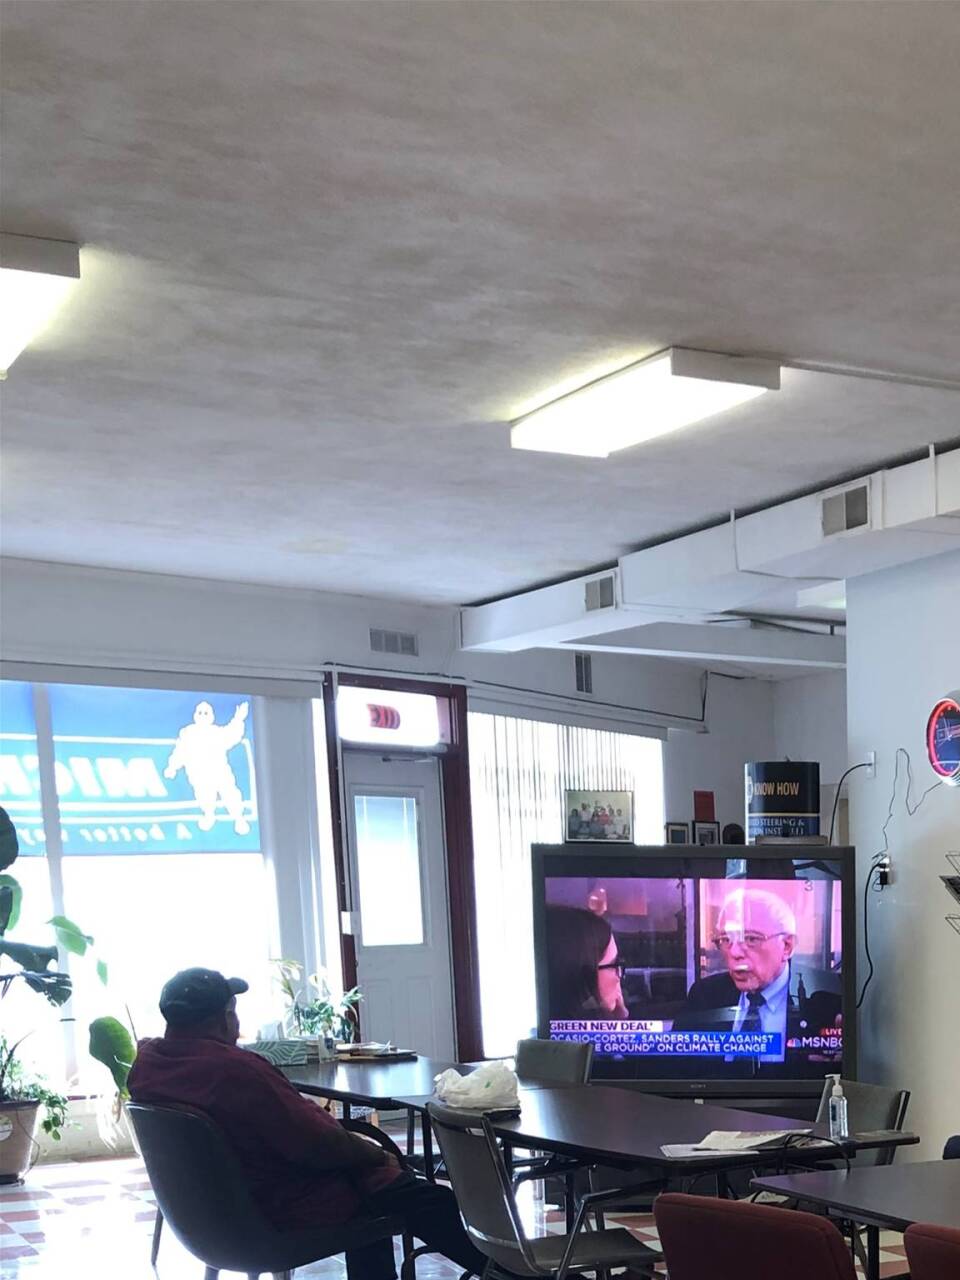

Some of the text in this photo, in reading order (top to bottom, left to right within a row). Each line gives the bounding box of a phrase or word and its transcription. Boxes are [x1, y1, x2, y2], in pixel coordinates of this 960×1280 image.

[777, 782, 800, 796] HOW
[591, 1022, 617, 1031] NEW
[642, 1034, 690, 1043] SANDERS
[692, 1034, 725, 1043] RALLY
[728, 1034, 774, 1043] AGAINST
[657, 1043, 674, 1052] ON
[676, 1043, 721, 1052] CLIMATE
[723, 1043, 767, 1053] CHANGE
